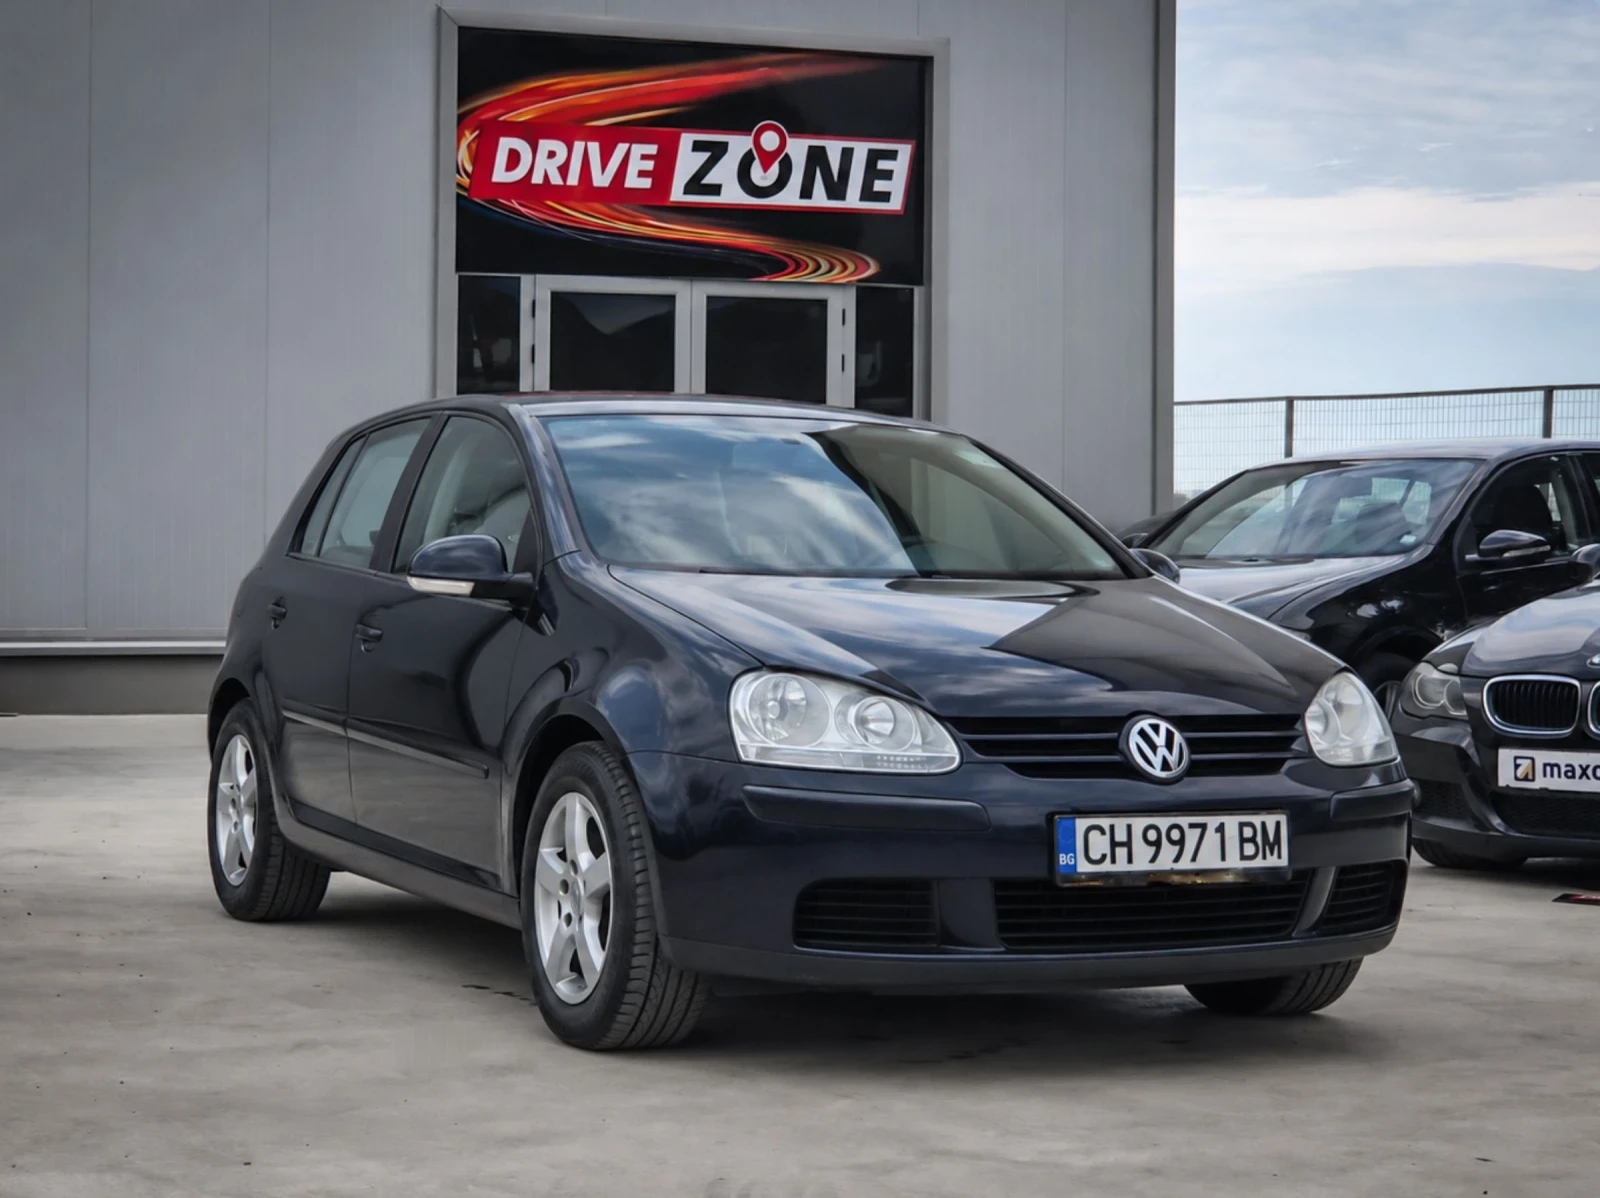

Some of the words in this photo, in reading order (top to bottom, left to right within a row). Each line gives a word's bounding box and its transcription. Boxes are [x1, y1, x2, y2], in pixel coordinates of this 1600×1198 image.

[491, 136, 659, 189] DRIVE
[682, 139, 899, 204] ZONE
[1129, 718, 1189, 778] VW
[1059, 853, 1075, 866] BG
[1083, 823, 1134, 865] CH
[1141, 821, 1227, 864] 9971
[1237, 820, 1283, 862] BM
